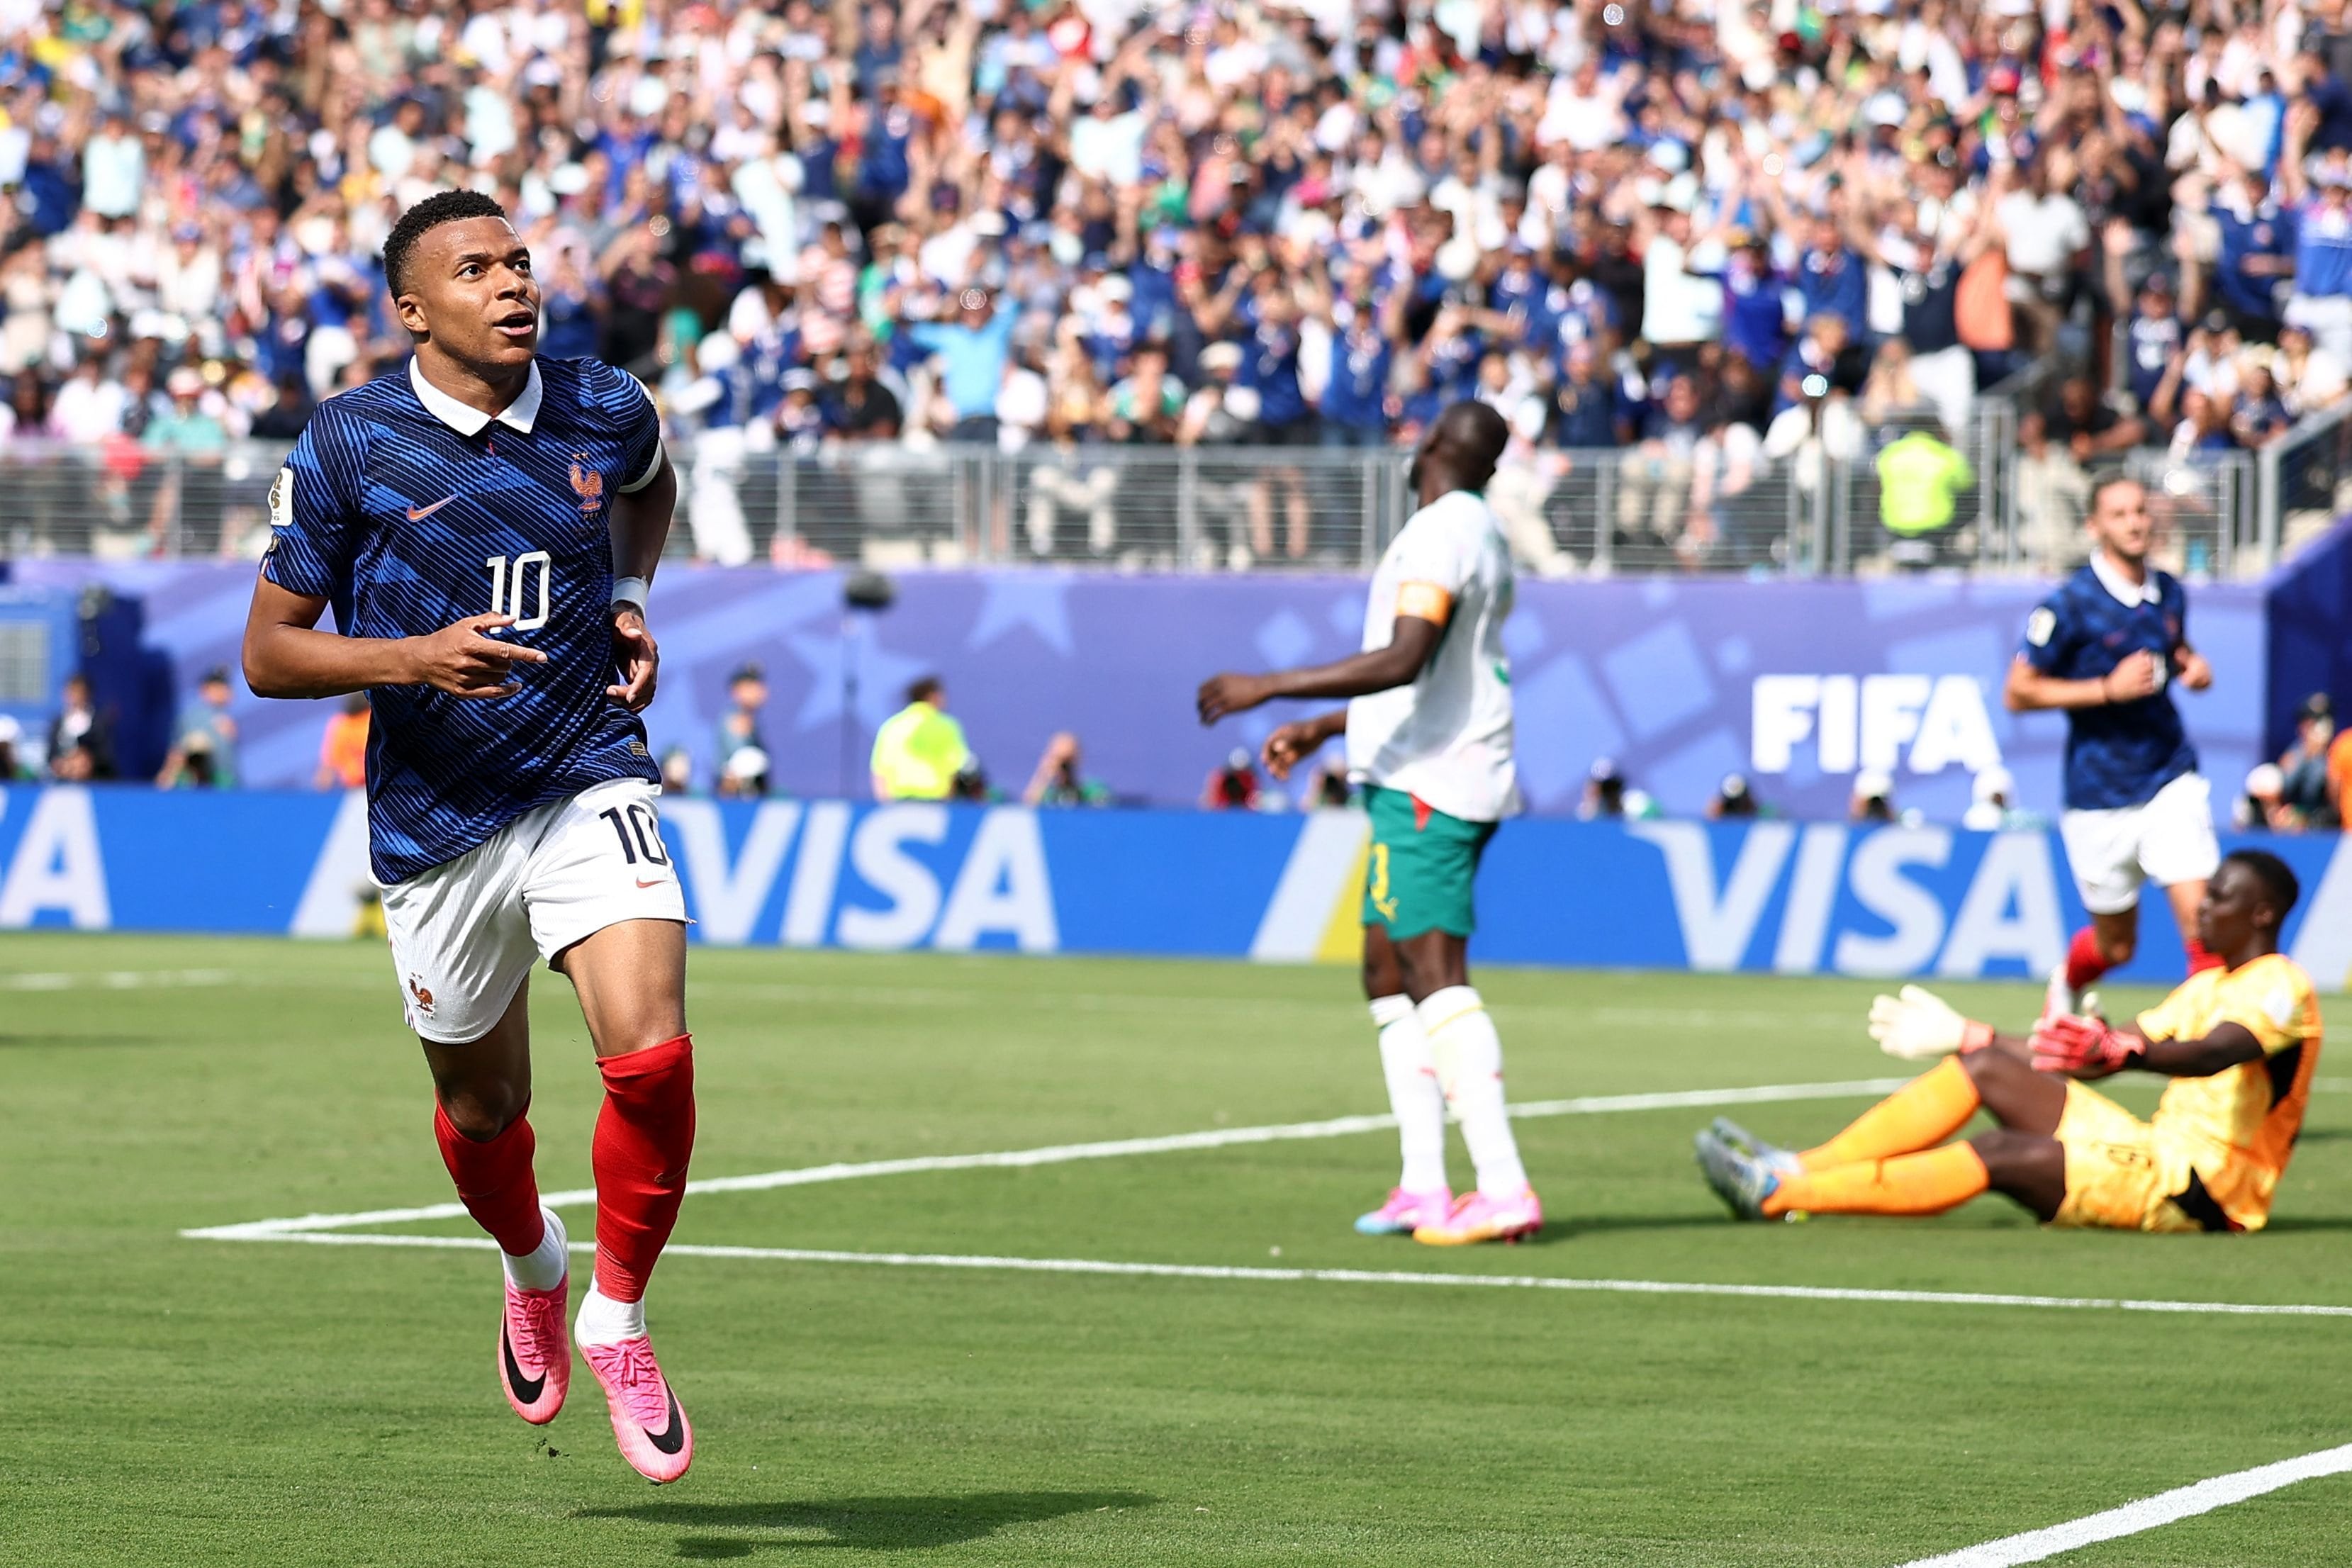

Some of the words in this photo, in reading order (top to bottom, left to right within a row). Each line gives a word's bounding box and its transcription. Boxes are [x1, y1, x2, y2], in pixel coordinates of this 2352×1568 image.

[486, 550, 551, 634] 10
[1752, 674, 2003, 773] FIFA
[0, 785, 113, 930] A
[599, 804, 668, 866] 10
[658, 799, 1059, 951] VISA
[1626, 822, 2068, 978] VISA
